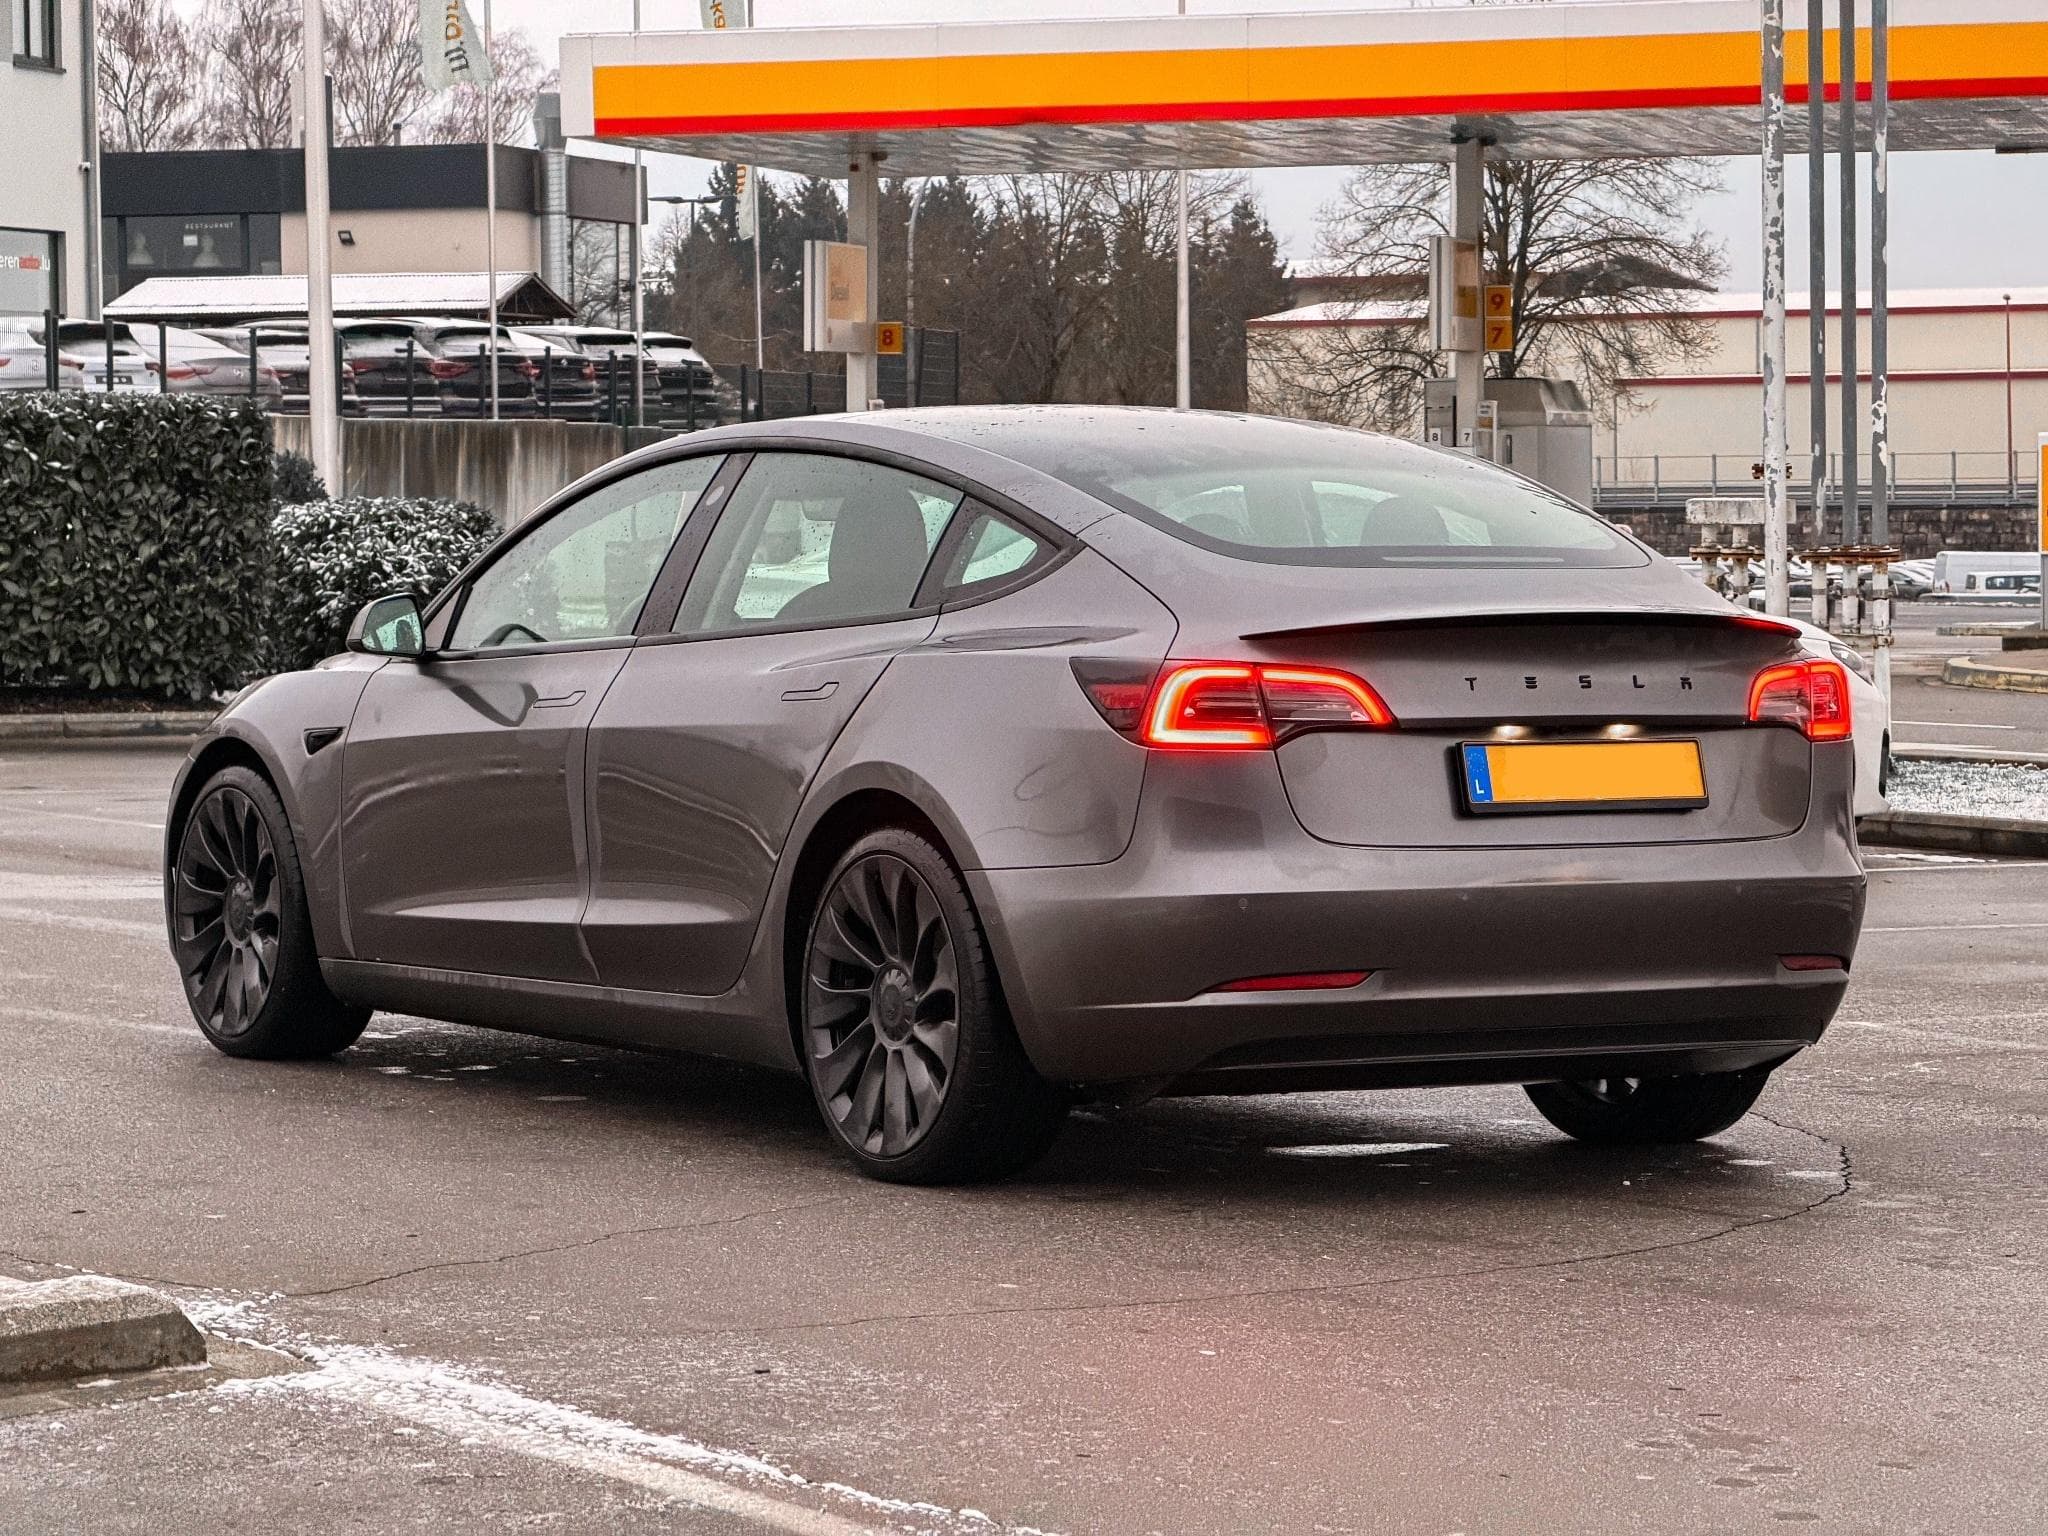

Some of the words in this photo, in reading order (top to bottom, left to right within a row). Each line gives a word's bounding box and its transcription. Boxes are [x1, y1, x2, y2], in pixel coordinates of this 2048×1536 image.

[185, 221, 233, 229] RESTAURANT
[1491, 293, 1504, 310] 9
[882, 328, 893, 345] 8
[1492, 326, 1504, 343] 7
[1432, 433, 1439, 442] 8
[1464, 433, 1470, 442] 7
[1464, 675, 1693, 690] TESLA
[1475, 779, 1485, 794] L
